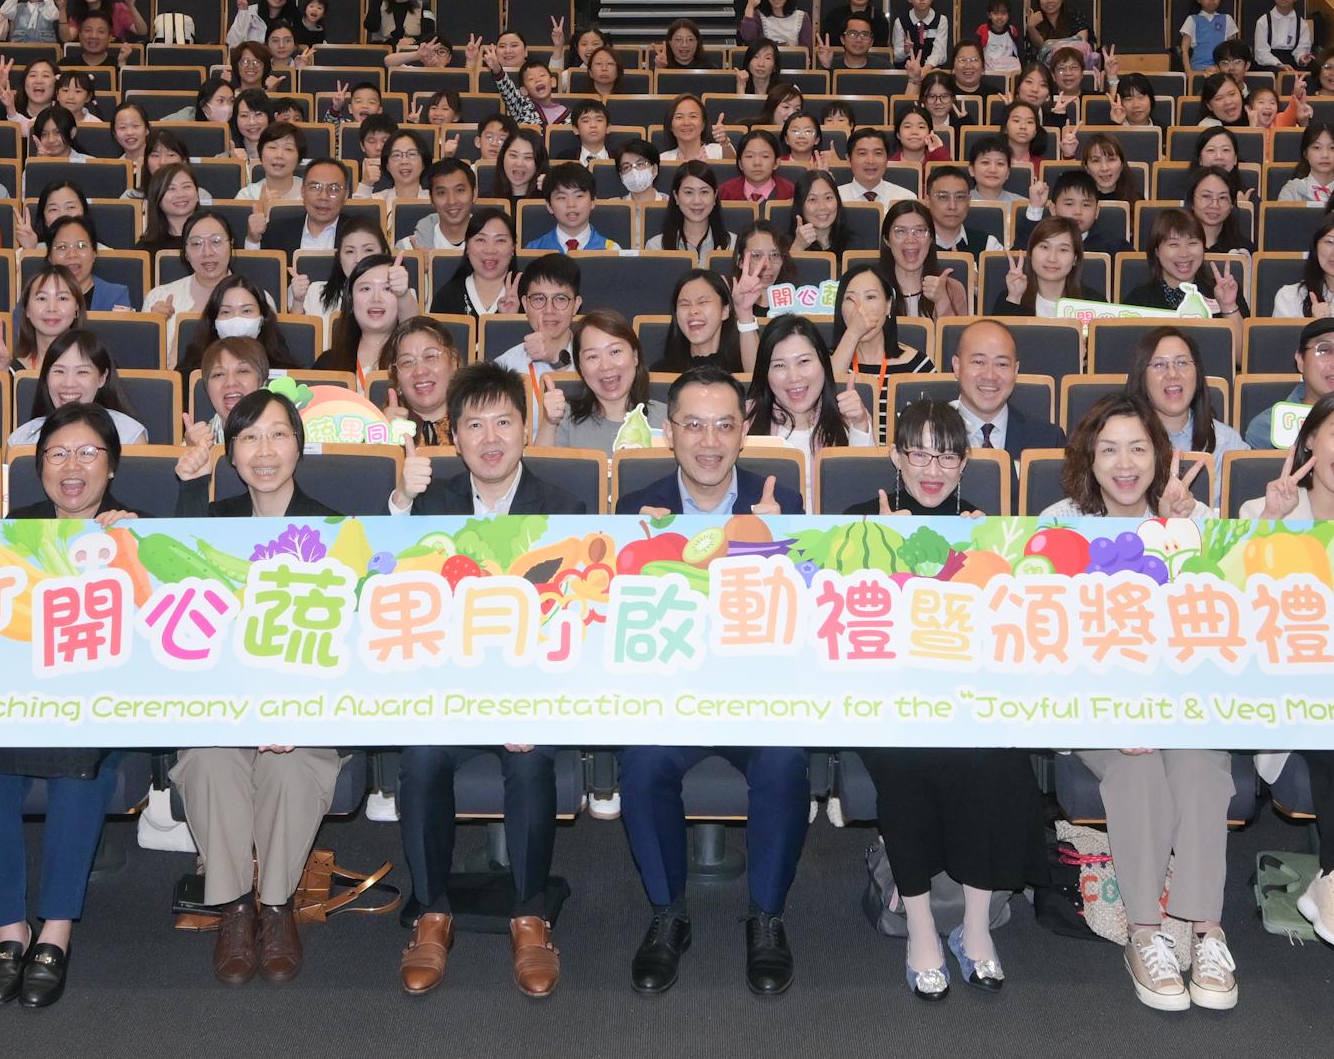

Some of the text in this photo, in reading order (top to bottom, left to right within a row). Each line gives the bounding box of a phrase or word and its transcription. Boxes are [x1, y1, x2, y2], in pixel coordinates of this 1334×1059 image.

[91, 695, 250, 721] Ceremony
[258, 695, 325, 718] and
[332, 695, 435, 718] Award
[444, 693, 664, 718] Presentation
[674, 693, 832, 720] Ceremony
[843, 694, 884, 718] for
[895, 695, 953, 718] the
[1089, 696, 1173, 720] Fruit
[1184, 697, 1205, 720] &
[1213, 698, 1277, 724] Veg
